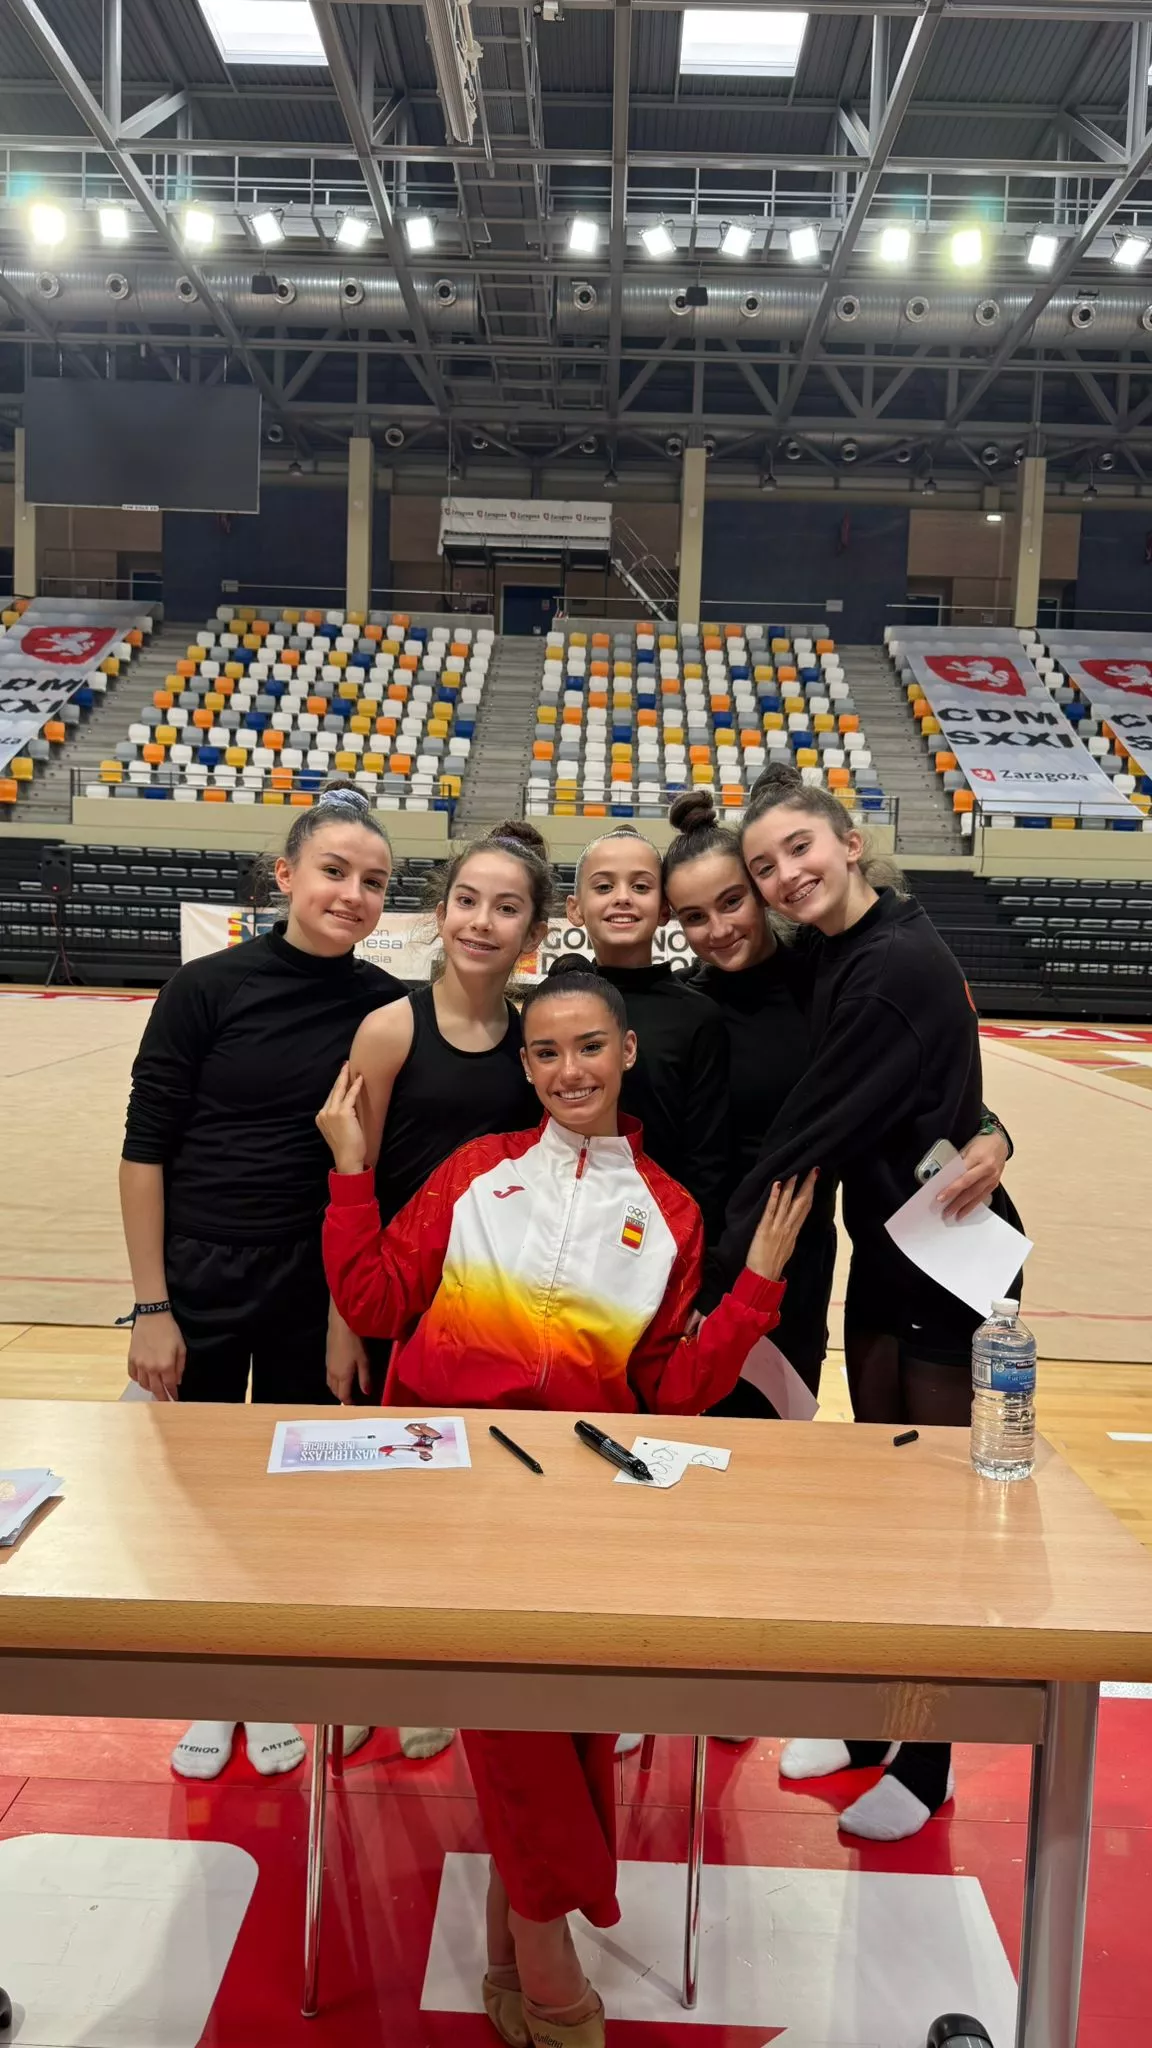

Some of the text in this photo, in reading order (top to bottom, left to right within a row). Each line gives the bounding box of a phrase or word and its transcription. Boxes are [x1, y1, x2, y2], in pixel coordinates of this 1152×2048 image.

[0, 678, 83, 693] DM
[937, 708, 1058, 725] CDM
[1111, 713, 1152, 728] C
[946, 730, 1075, 748] SXXI
[1000, 769, 1089, 782] Zaragoza
[300, 1447, 379, 1461] MASTERCLASS
